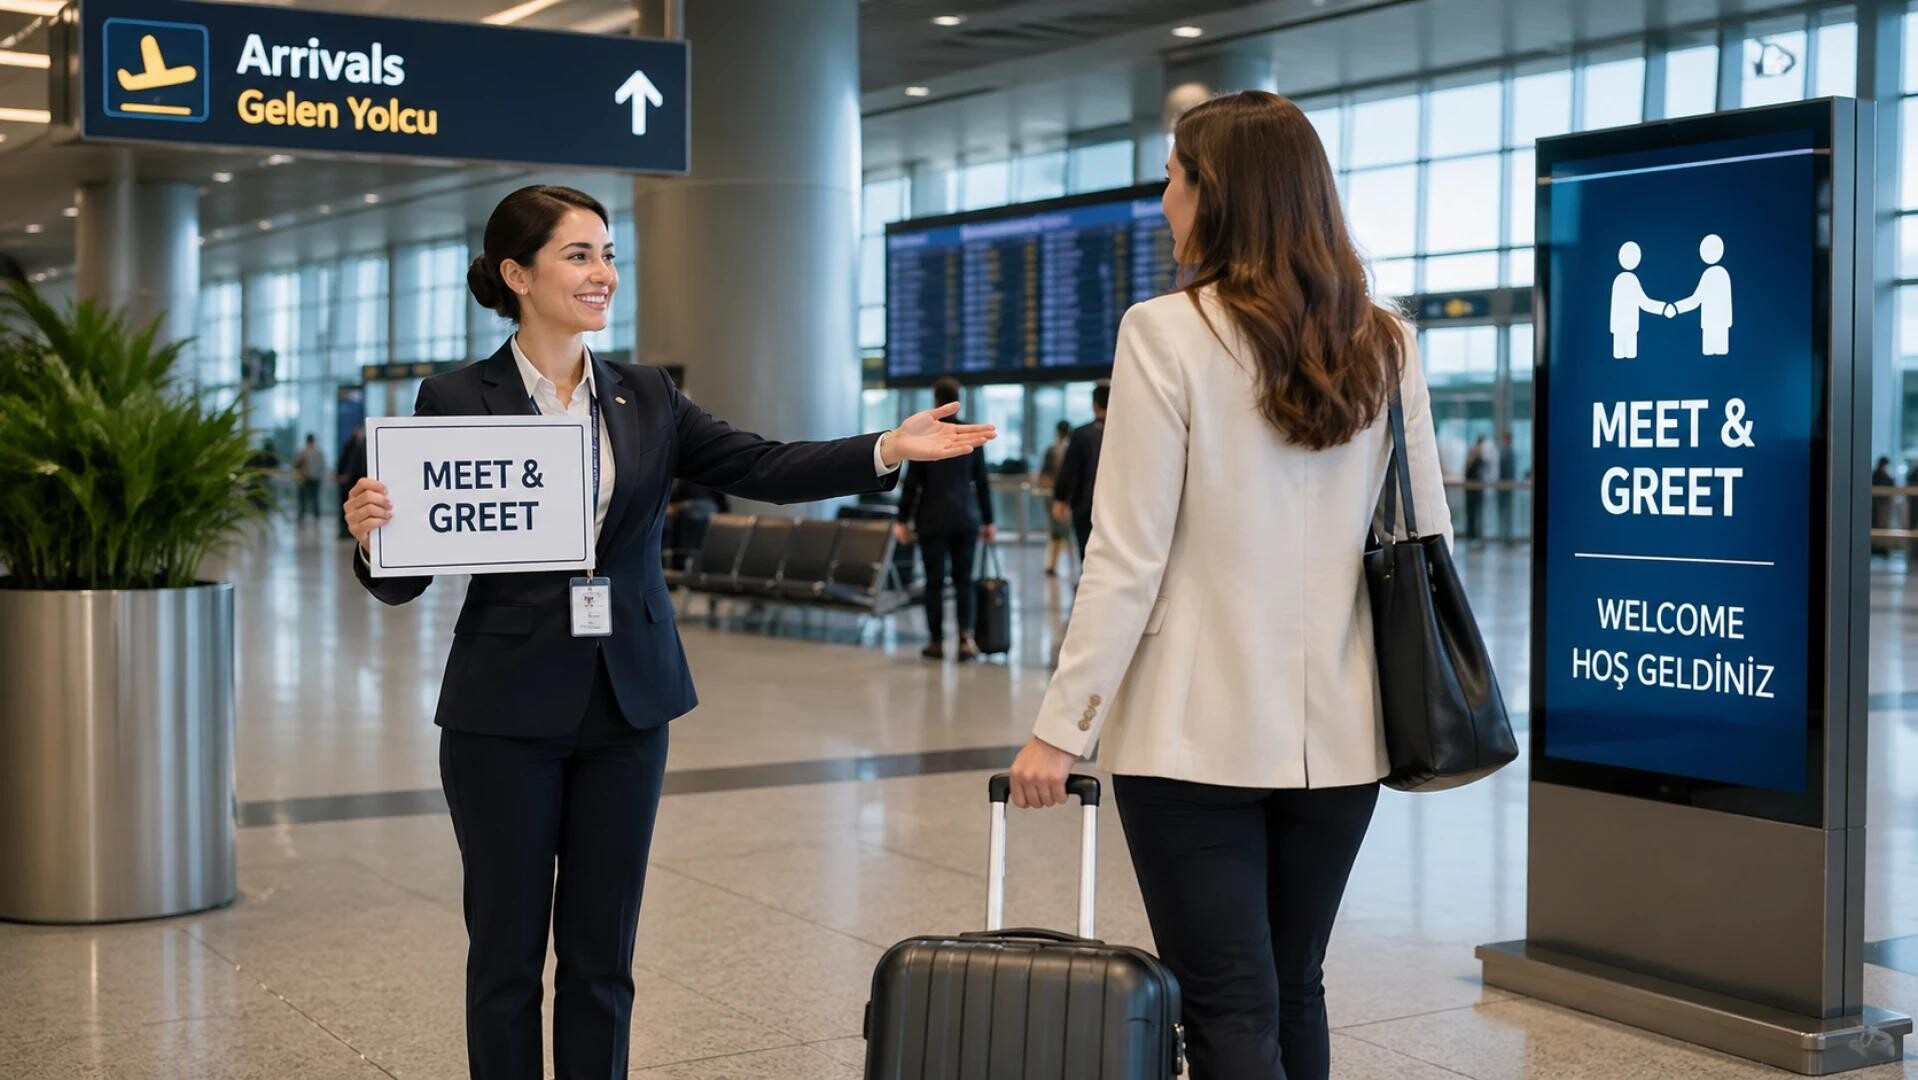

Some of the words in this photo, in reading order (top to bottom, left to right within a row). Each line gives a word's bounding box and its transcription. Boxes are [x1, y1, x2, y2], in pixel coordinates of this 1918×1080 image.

[236, 33, 405, 86] Arrivals
[237, 88, 339, 129] Gelen
[346, 96, 438, 135] Yolcu
[1592, 399, 1709, 448] MEET
[1720, 397, 1755, 448] &
[423, 459, 514, 491] MEET
[521, 458, 544, 489] &
[1600, 466, 1744, 517] GREET
[428, 500, 539, 534] GREET
[1597, 597, 1745, 640] WELCOME
[1573, 647, 1629, 691] HOŞ
[1637, 652, 1775, 699] GELDİNİZ
